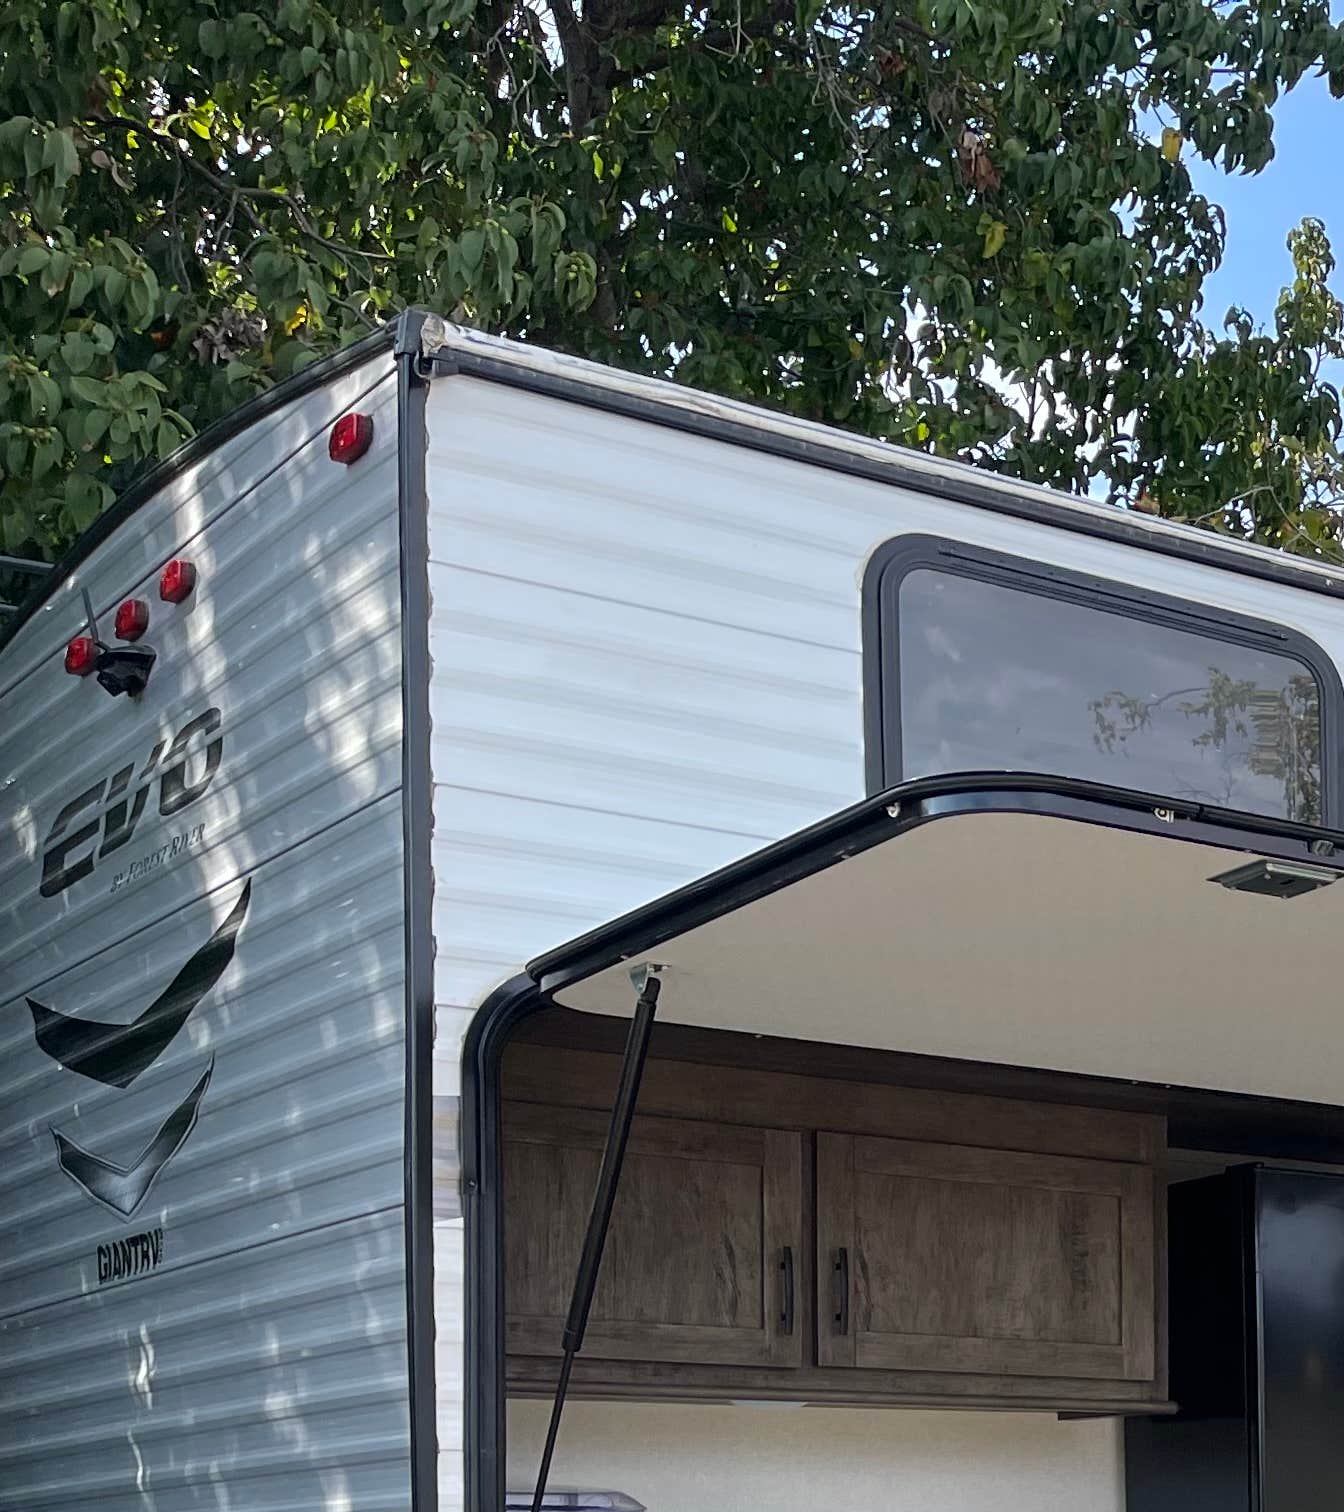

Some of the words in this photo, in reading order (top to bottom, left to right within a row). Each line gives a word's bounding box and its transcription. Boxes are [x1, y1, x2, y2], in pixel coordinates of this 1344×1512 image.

[39, 707, 224, 898] EVO
[126, 843, 171, 886] FOREST
[168, 822, 206, 858] RIVER
